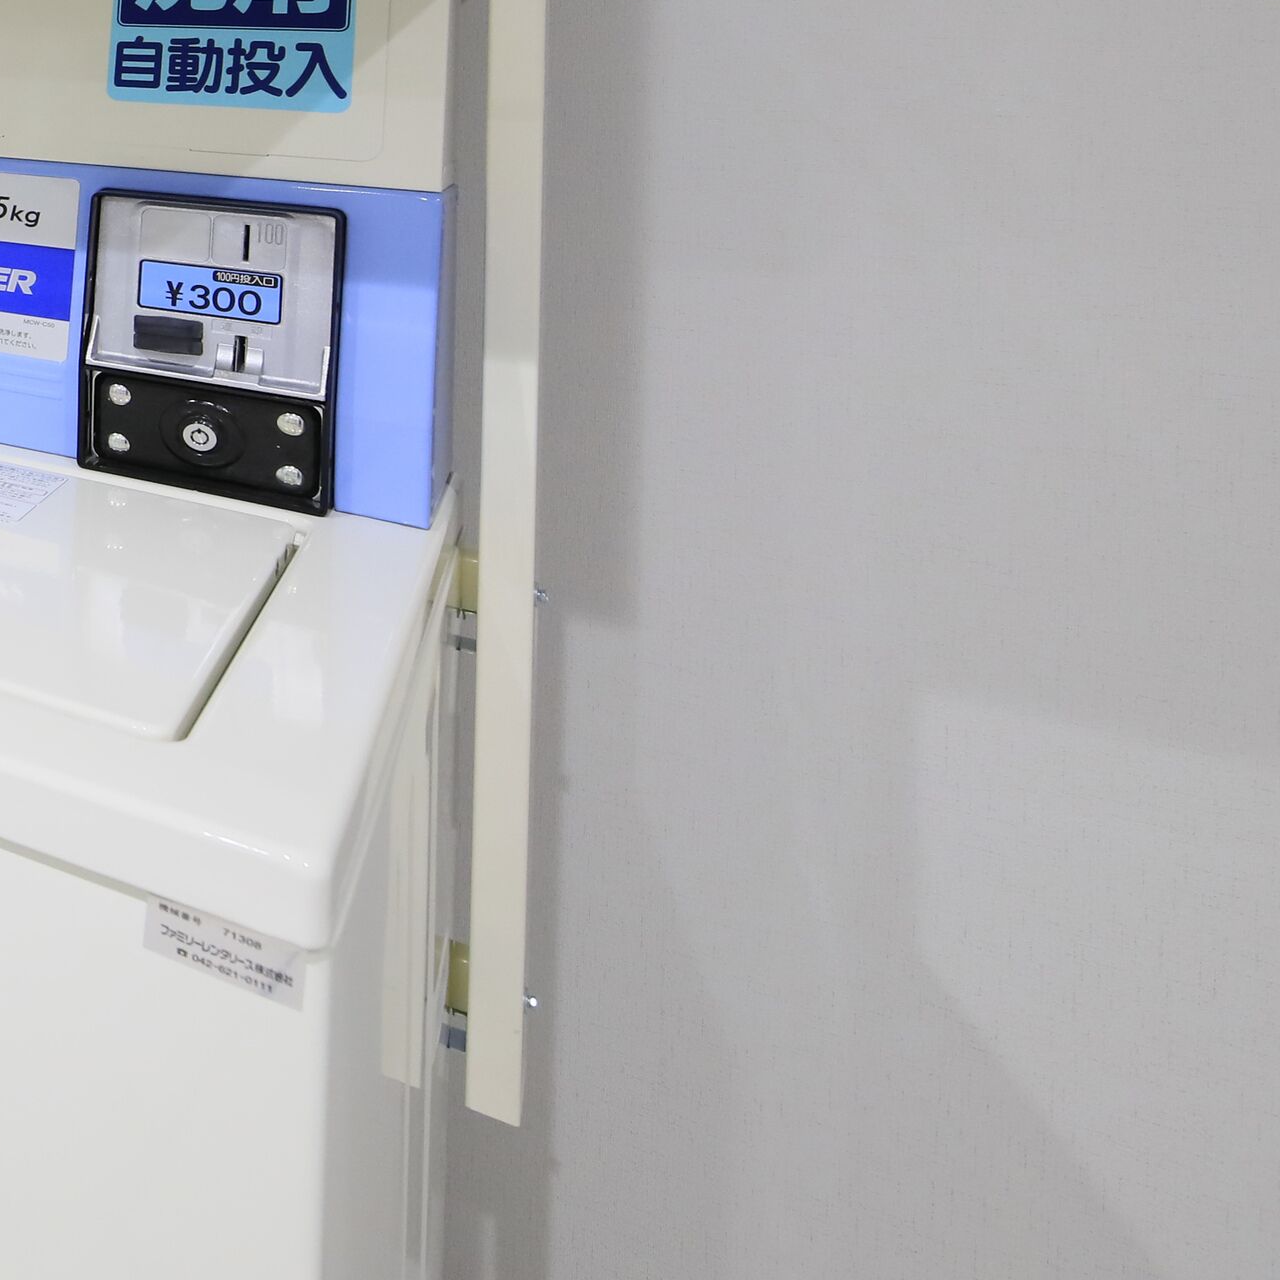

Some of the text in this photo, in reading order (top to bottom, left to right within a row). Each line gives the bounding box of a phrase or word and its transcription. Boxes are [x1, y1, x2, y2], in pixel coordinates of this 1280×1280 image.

[113, 34, 349, 101] 自動投入
[257, 222, 284, 245] 100
[216, 271, 275, 287] 100円投入口
[165, 280, 262, 316] ¥300
[192, 954, 273, 993] 042-621-0111
